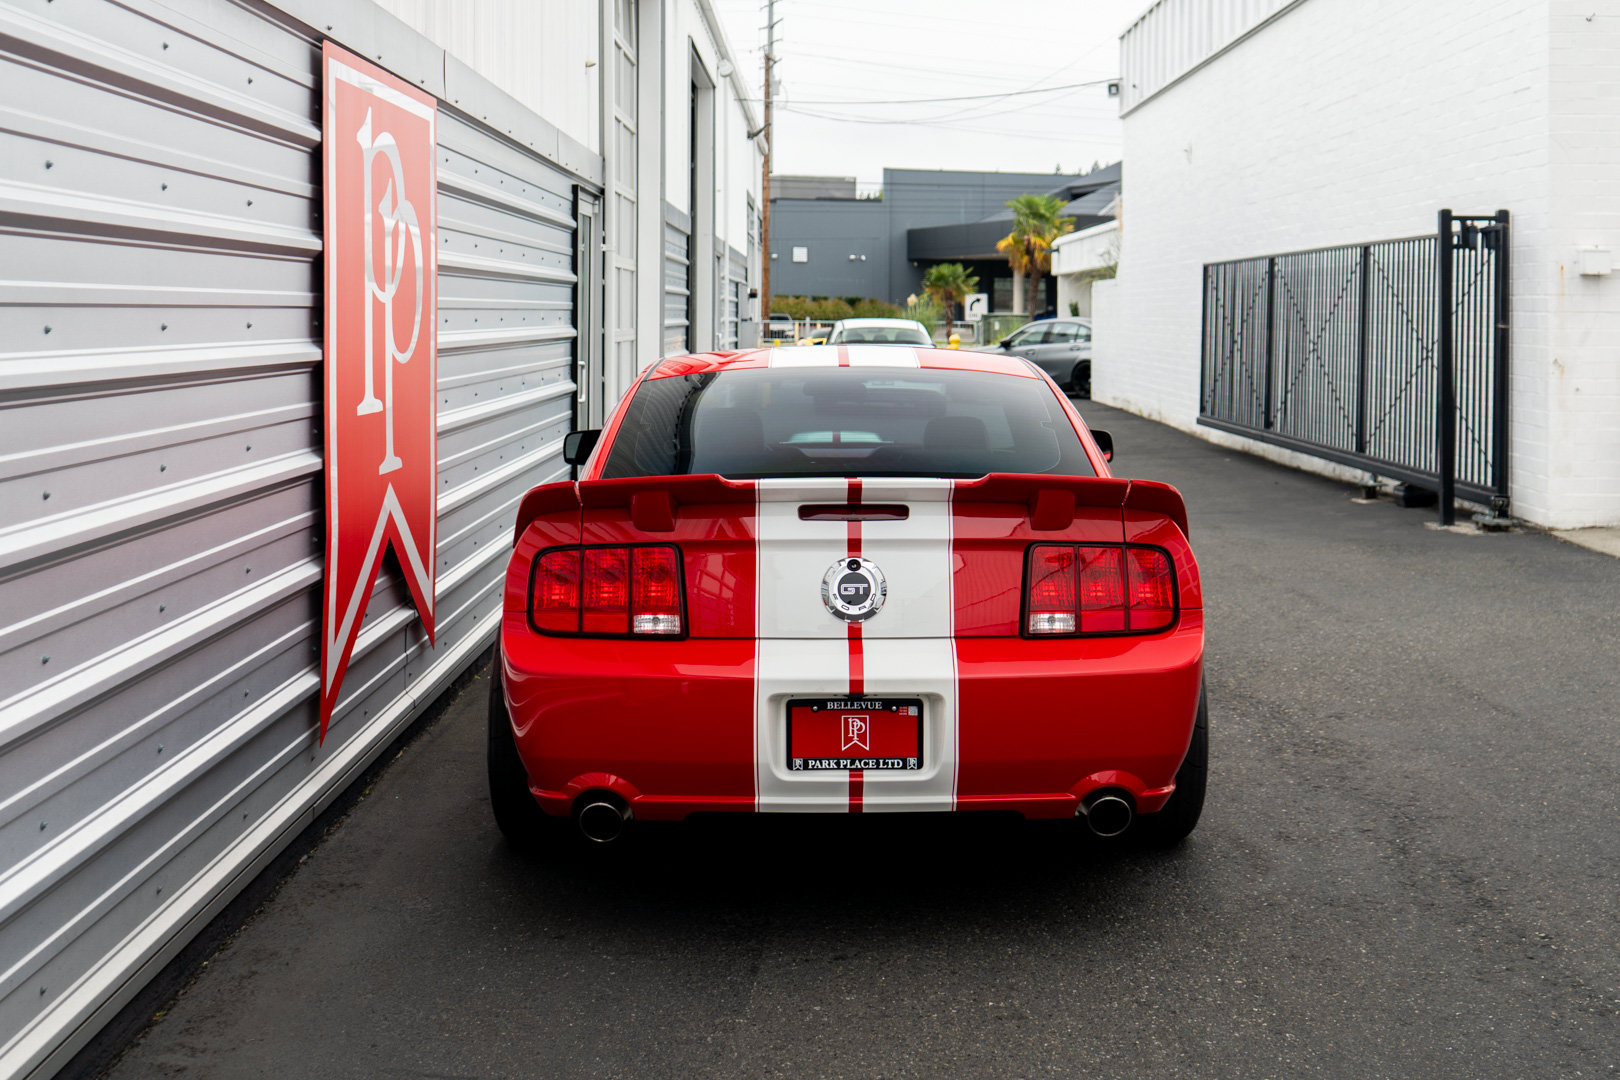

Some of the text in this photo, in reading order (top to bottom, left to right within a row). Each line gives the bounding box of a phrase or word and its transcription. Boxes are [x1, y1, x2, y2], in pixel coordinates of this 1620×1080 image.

[840, 583, 869, 595] GT
[826, 701, 883, 710] BELLEVUE
[808, 759, 838, 769] PARK
[839, 759, 877, 769] PLACE
[879, 759, 903, 769] LTD
